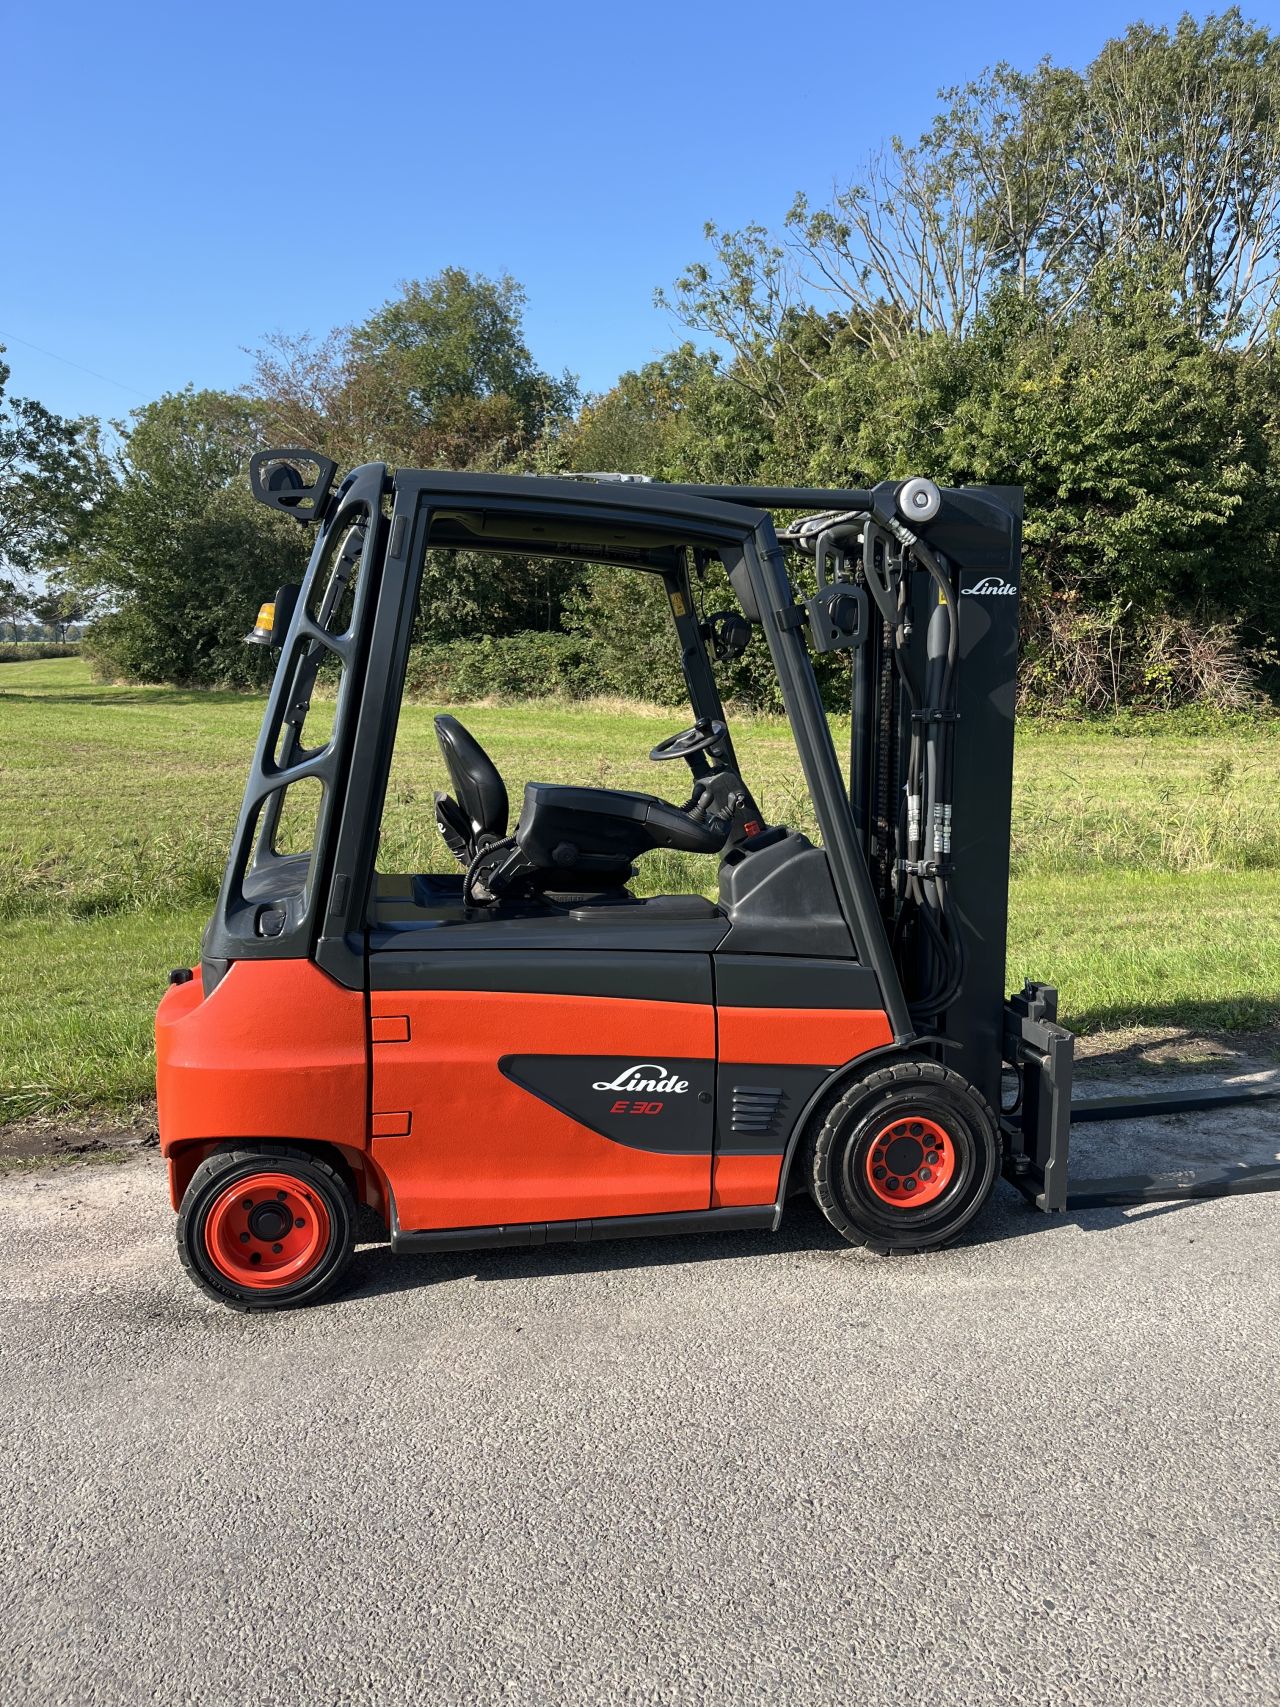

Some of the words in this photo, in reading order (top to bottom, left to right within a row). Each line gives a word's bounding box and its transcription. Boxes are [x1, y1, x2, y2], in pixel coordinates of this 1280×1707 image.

[961, 577, 1017, 595] Linde
[592, 1064, 689, 1094] Linde
[610, 1101, 630, 1113] E
[629, 1101, 664, 1114] 30
